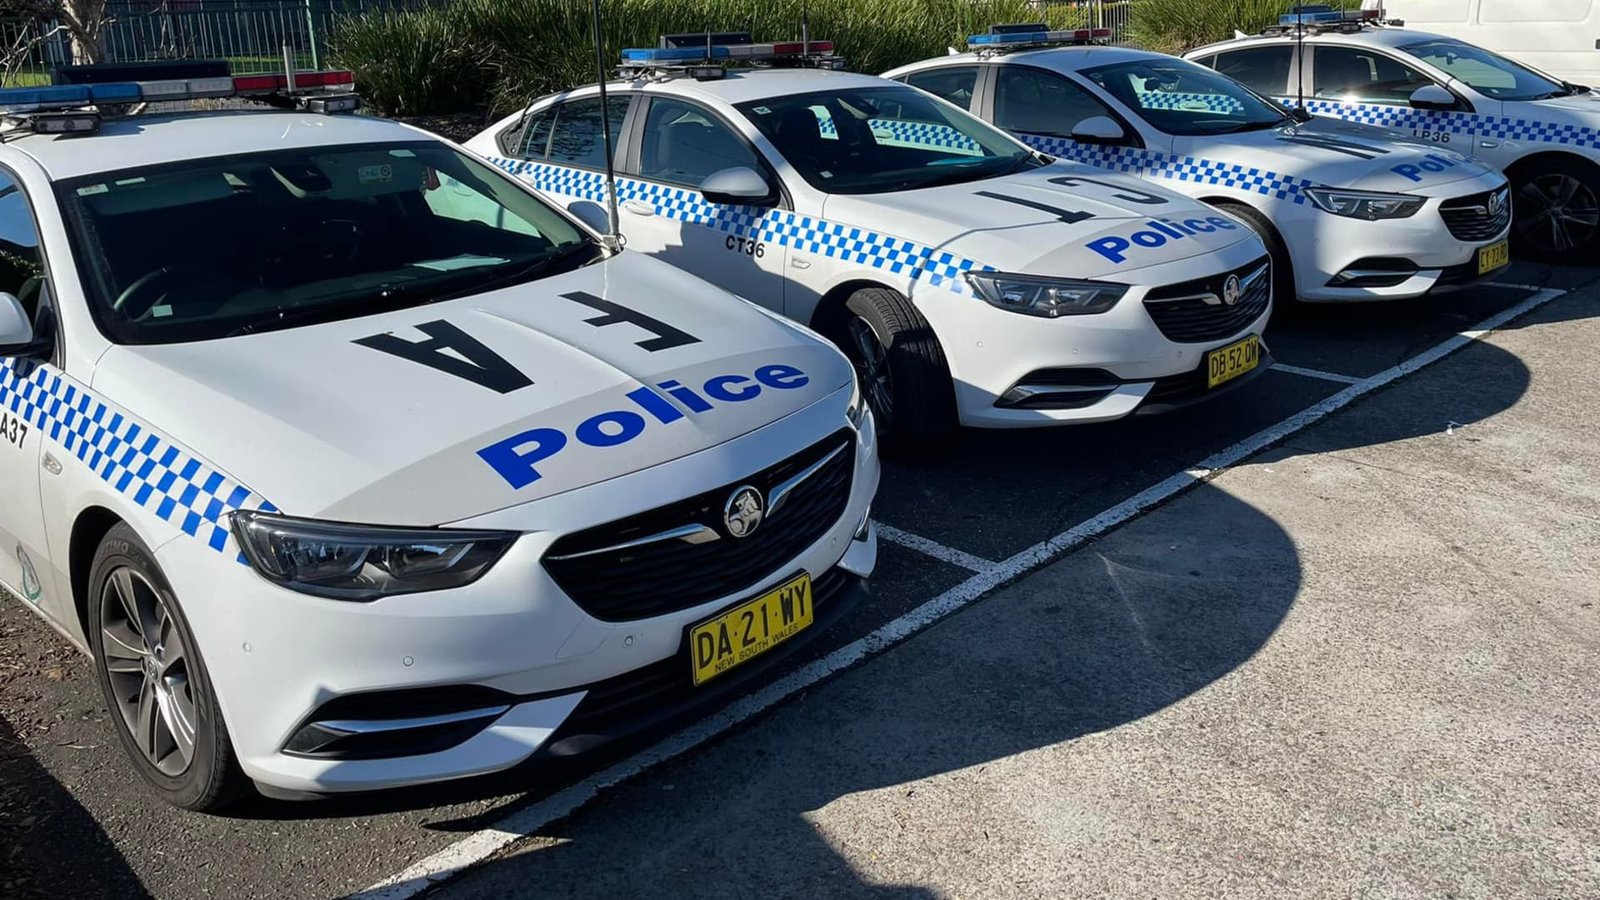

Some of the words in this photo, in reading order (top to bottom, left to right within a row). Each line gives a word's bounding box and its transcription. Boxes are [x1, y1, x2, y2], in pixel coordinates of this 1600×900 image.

[1391, 153, 1473, 183] Pol
[725, 234, 765, 259] CT36
[1085, 216, 1237, 264] Police
[475, 364, 811, 491] Police
[715, 655, 735, 672] NEW
[740, 640, 769, 660] SOUTH
[772, 622, 799, 643] WALES
